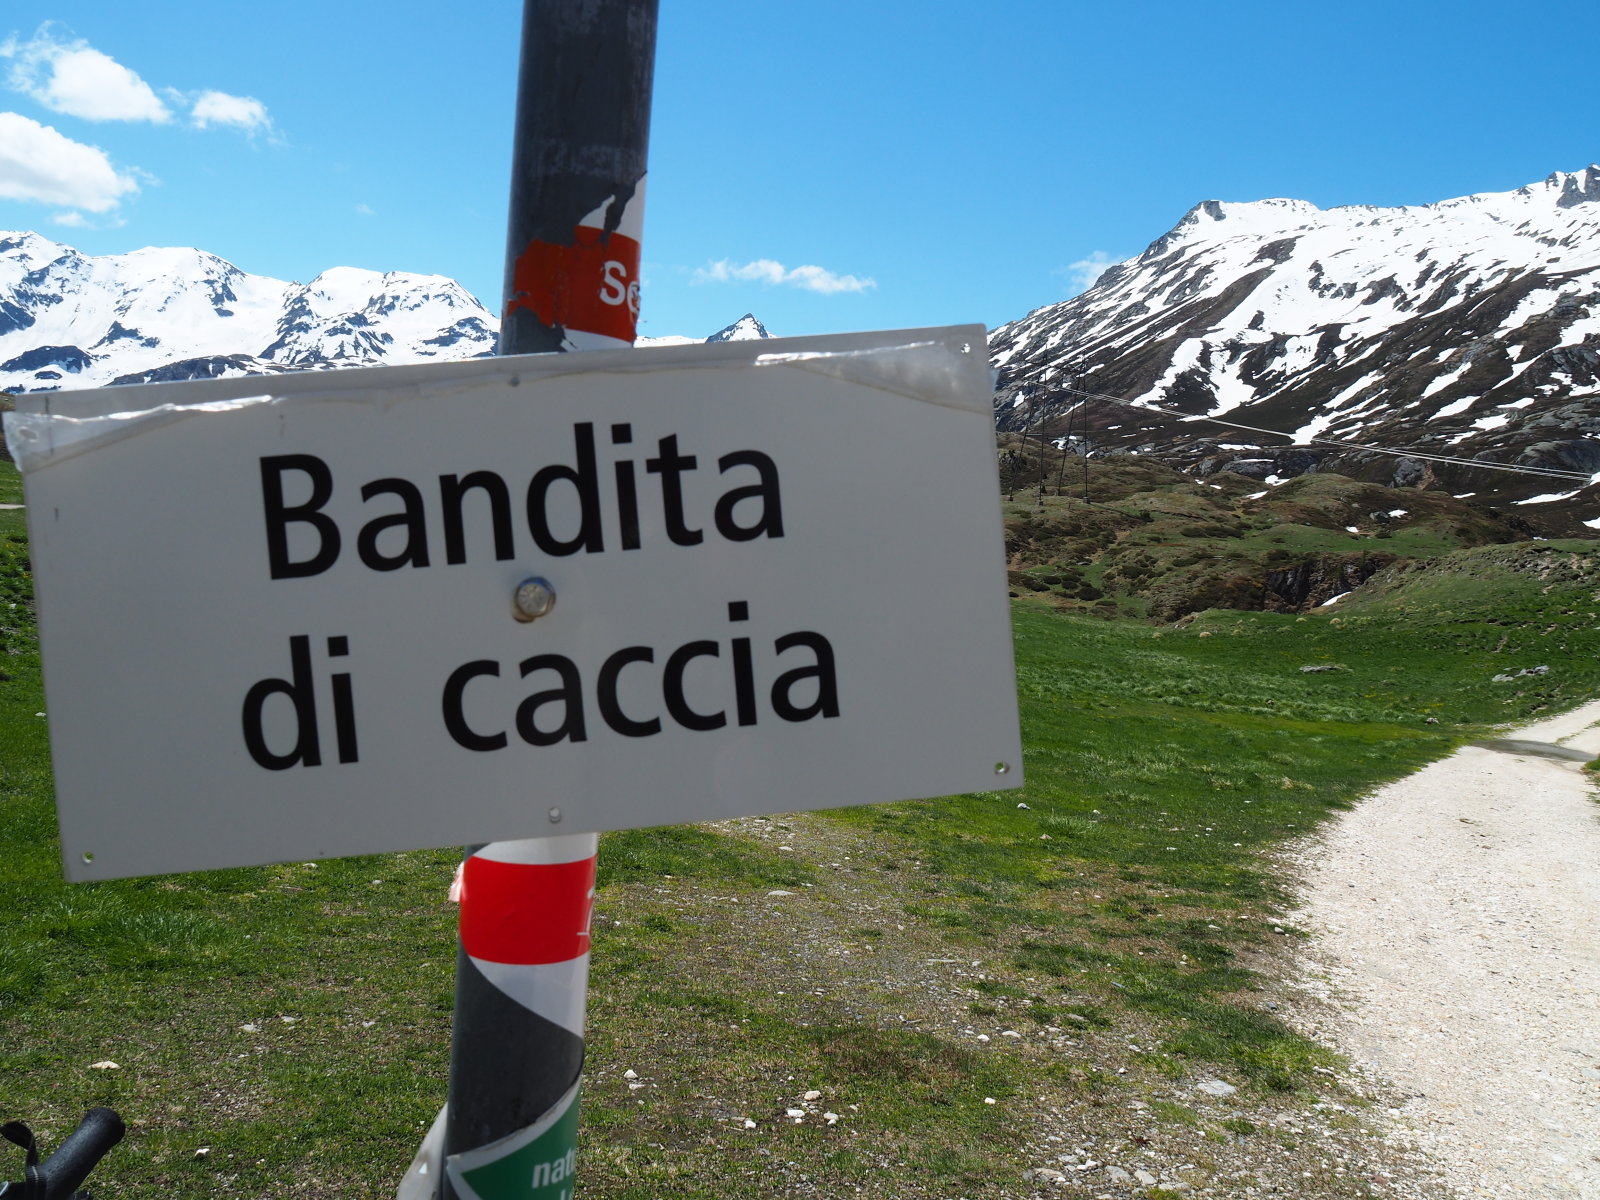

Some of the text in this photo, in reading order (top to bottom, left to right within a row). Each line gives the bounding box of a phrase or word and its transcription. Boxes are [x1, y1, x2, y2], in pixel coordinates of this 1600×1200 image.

[259, 421, 785, 580] Bandita
[241, 600, 841, 772] di caccia
